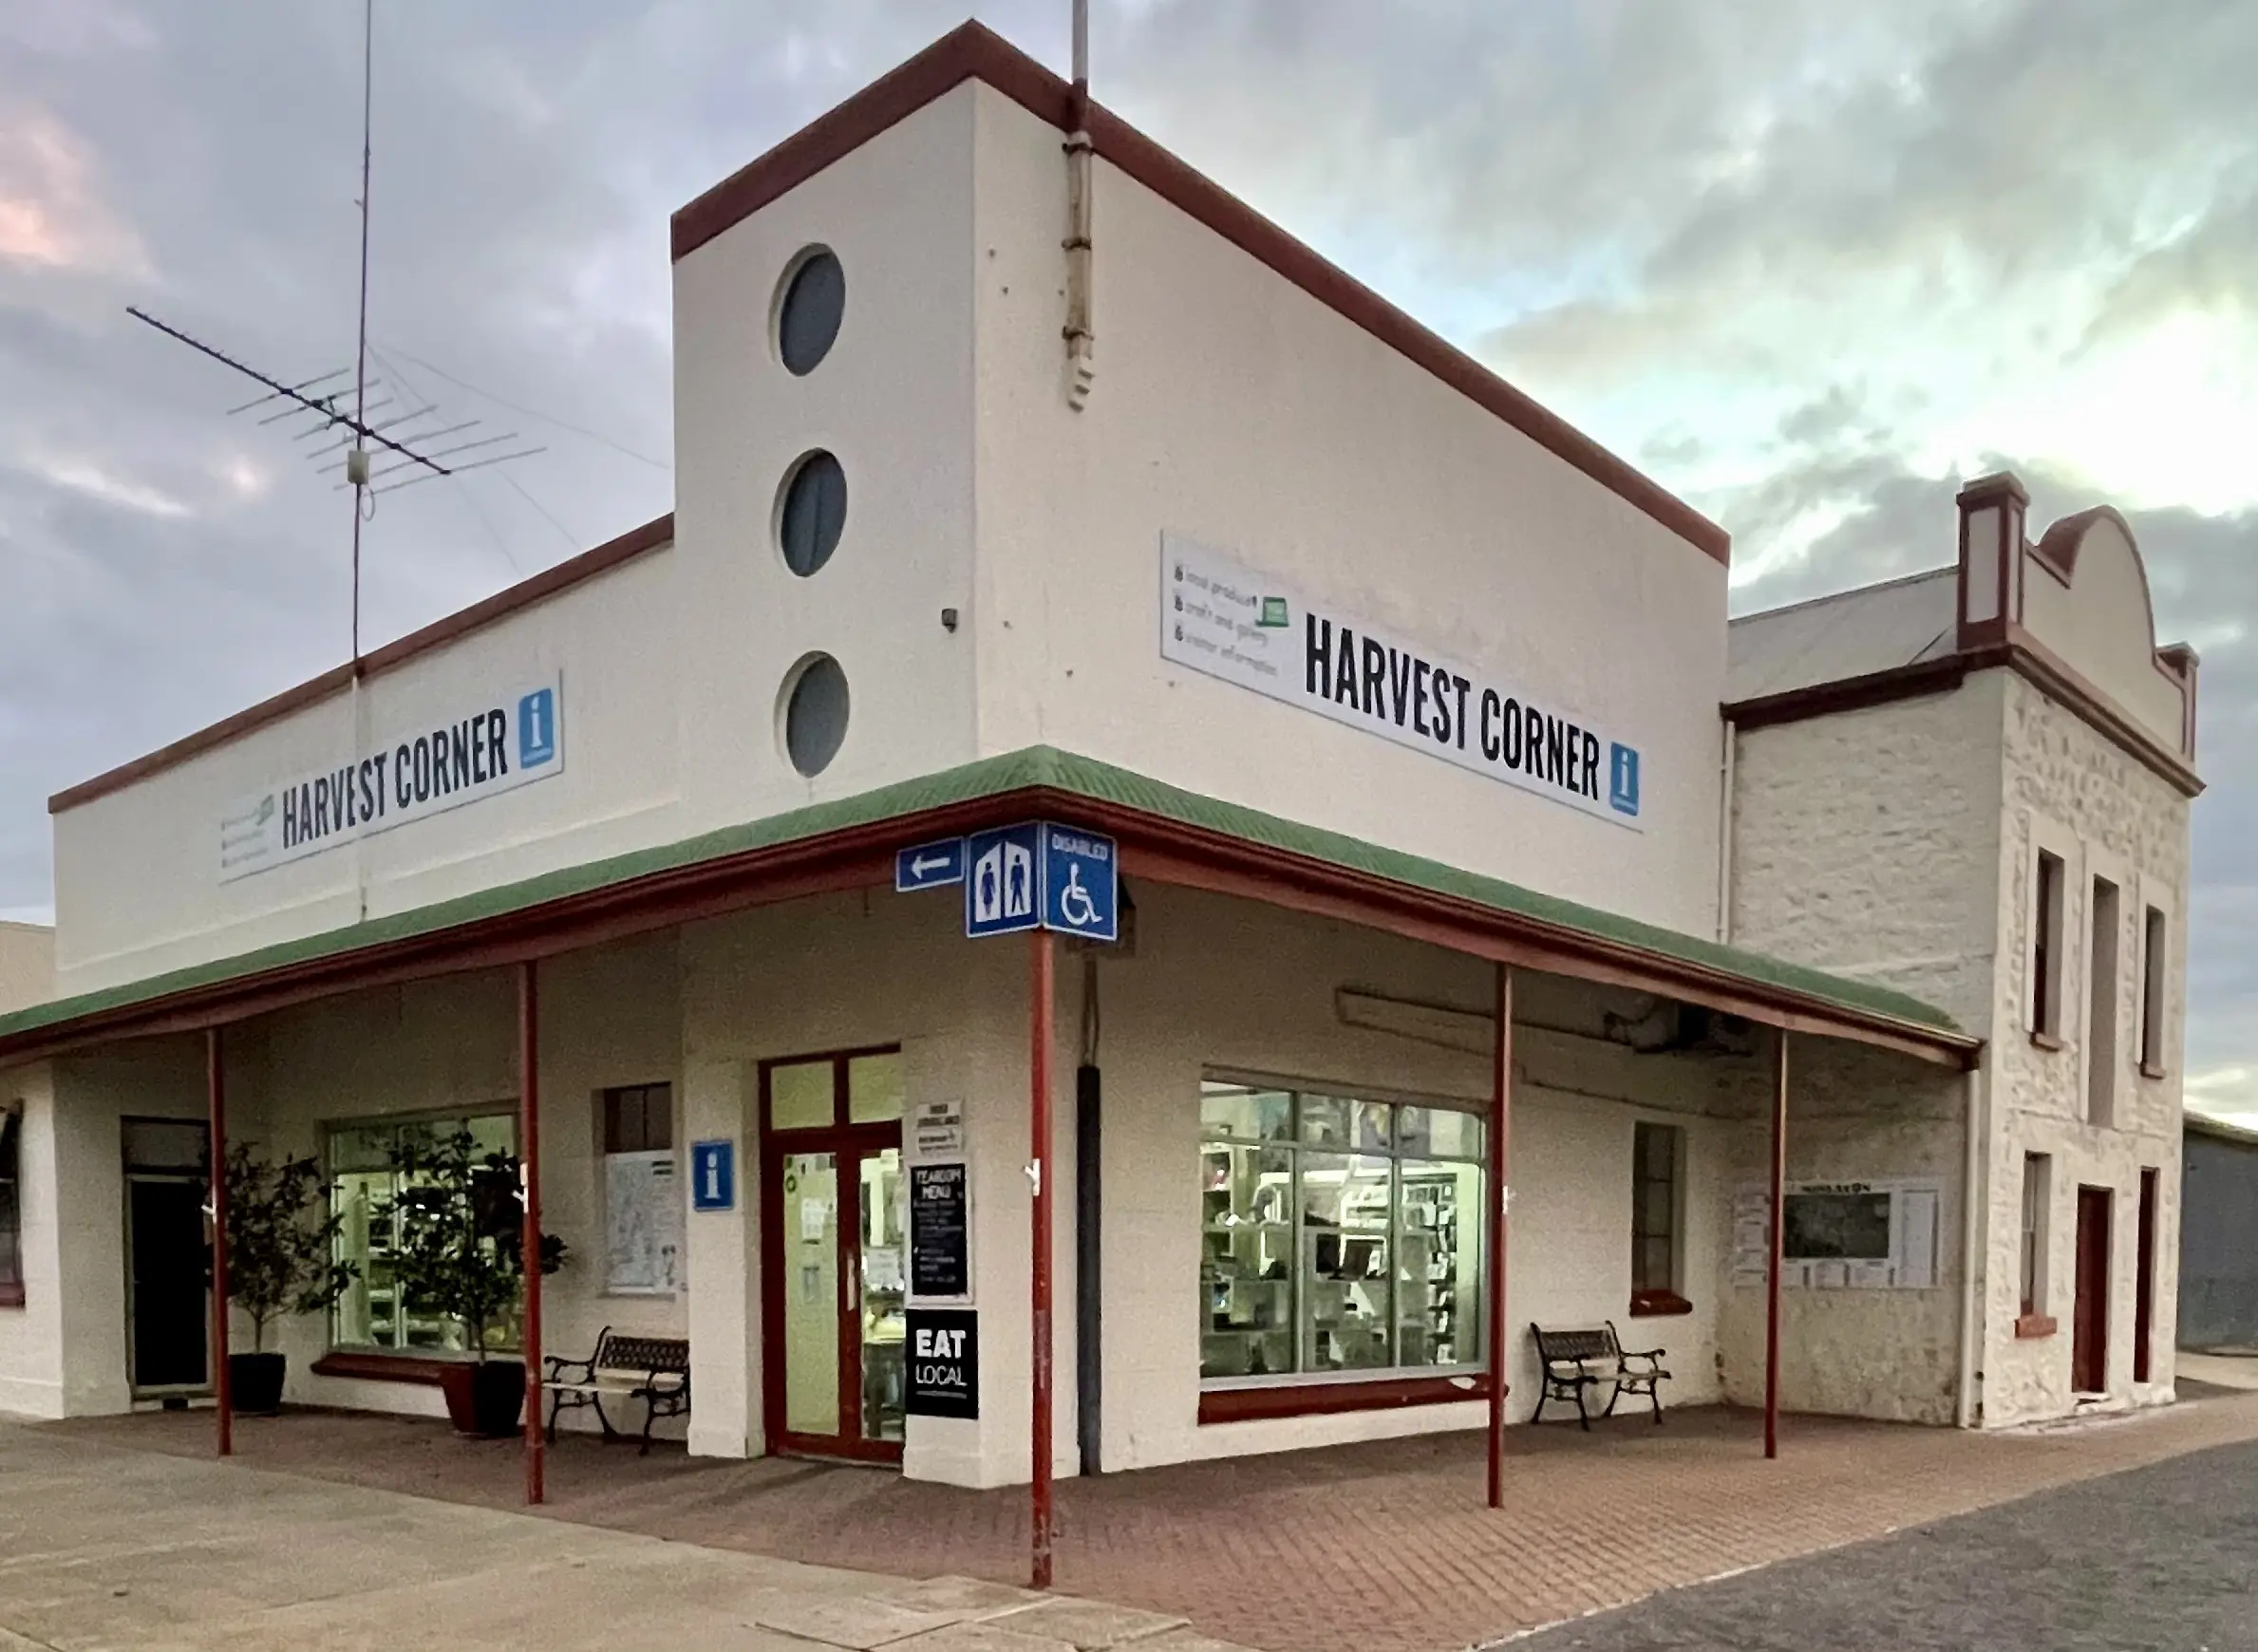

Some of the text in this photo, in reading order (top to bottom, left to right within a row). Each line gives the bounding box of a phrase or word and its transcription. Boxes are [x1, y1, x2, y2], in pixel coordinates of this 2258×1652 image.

[1306, 611, 1600, 801] HARVEST CORNER
[282, 708, 508, 850] HARVEST CORNER
[915, 1329, 967, 1359] EAT
[915, 1364, 968, 1386] LOCAL
